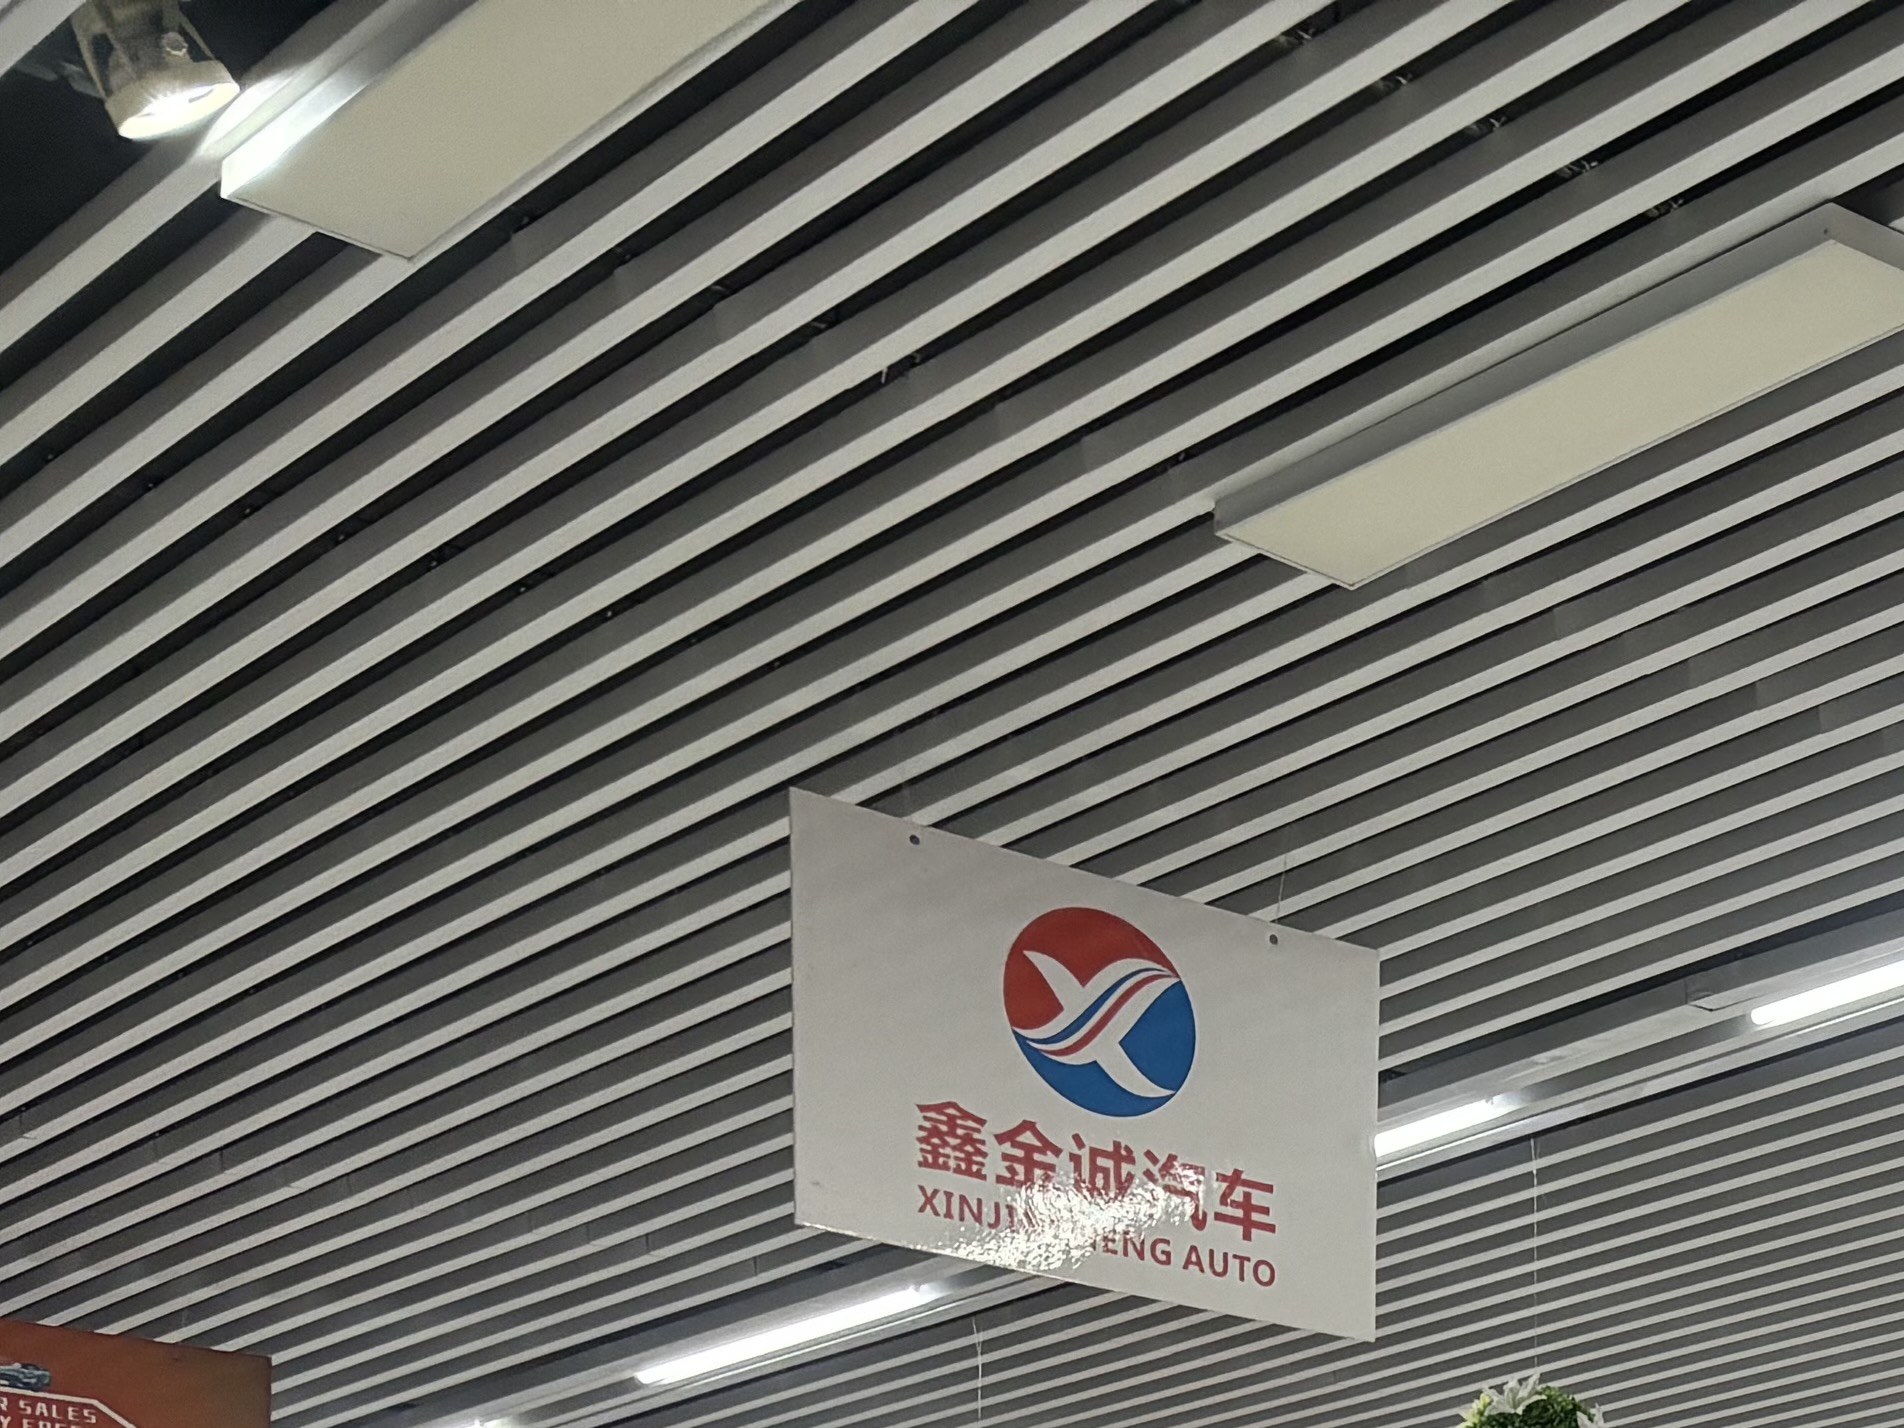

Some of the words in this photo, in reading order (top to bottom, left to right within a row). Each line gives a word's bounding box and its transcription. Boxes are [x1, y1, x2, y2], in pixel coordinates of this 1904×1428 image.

[915, 1100, 1277, 1243] 鑫金诚汽车
[1182, 1249, 1276, 1288] AUTO
[19, 1399, 97, 1424] SALES
